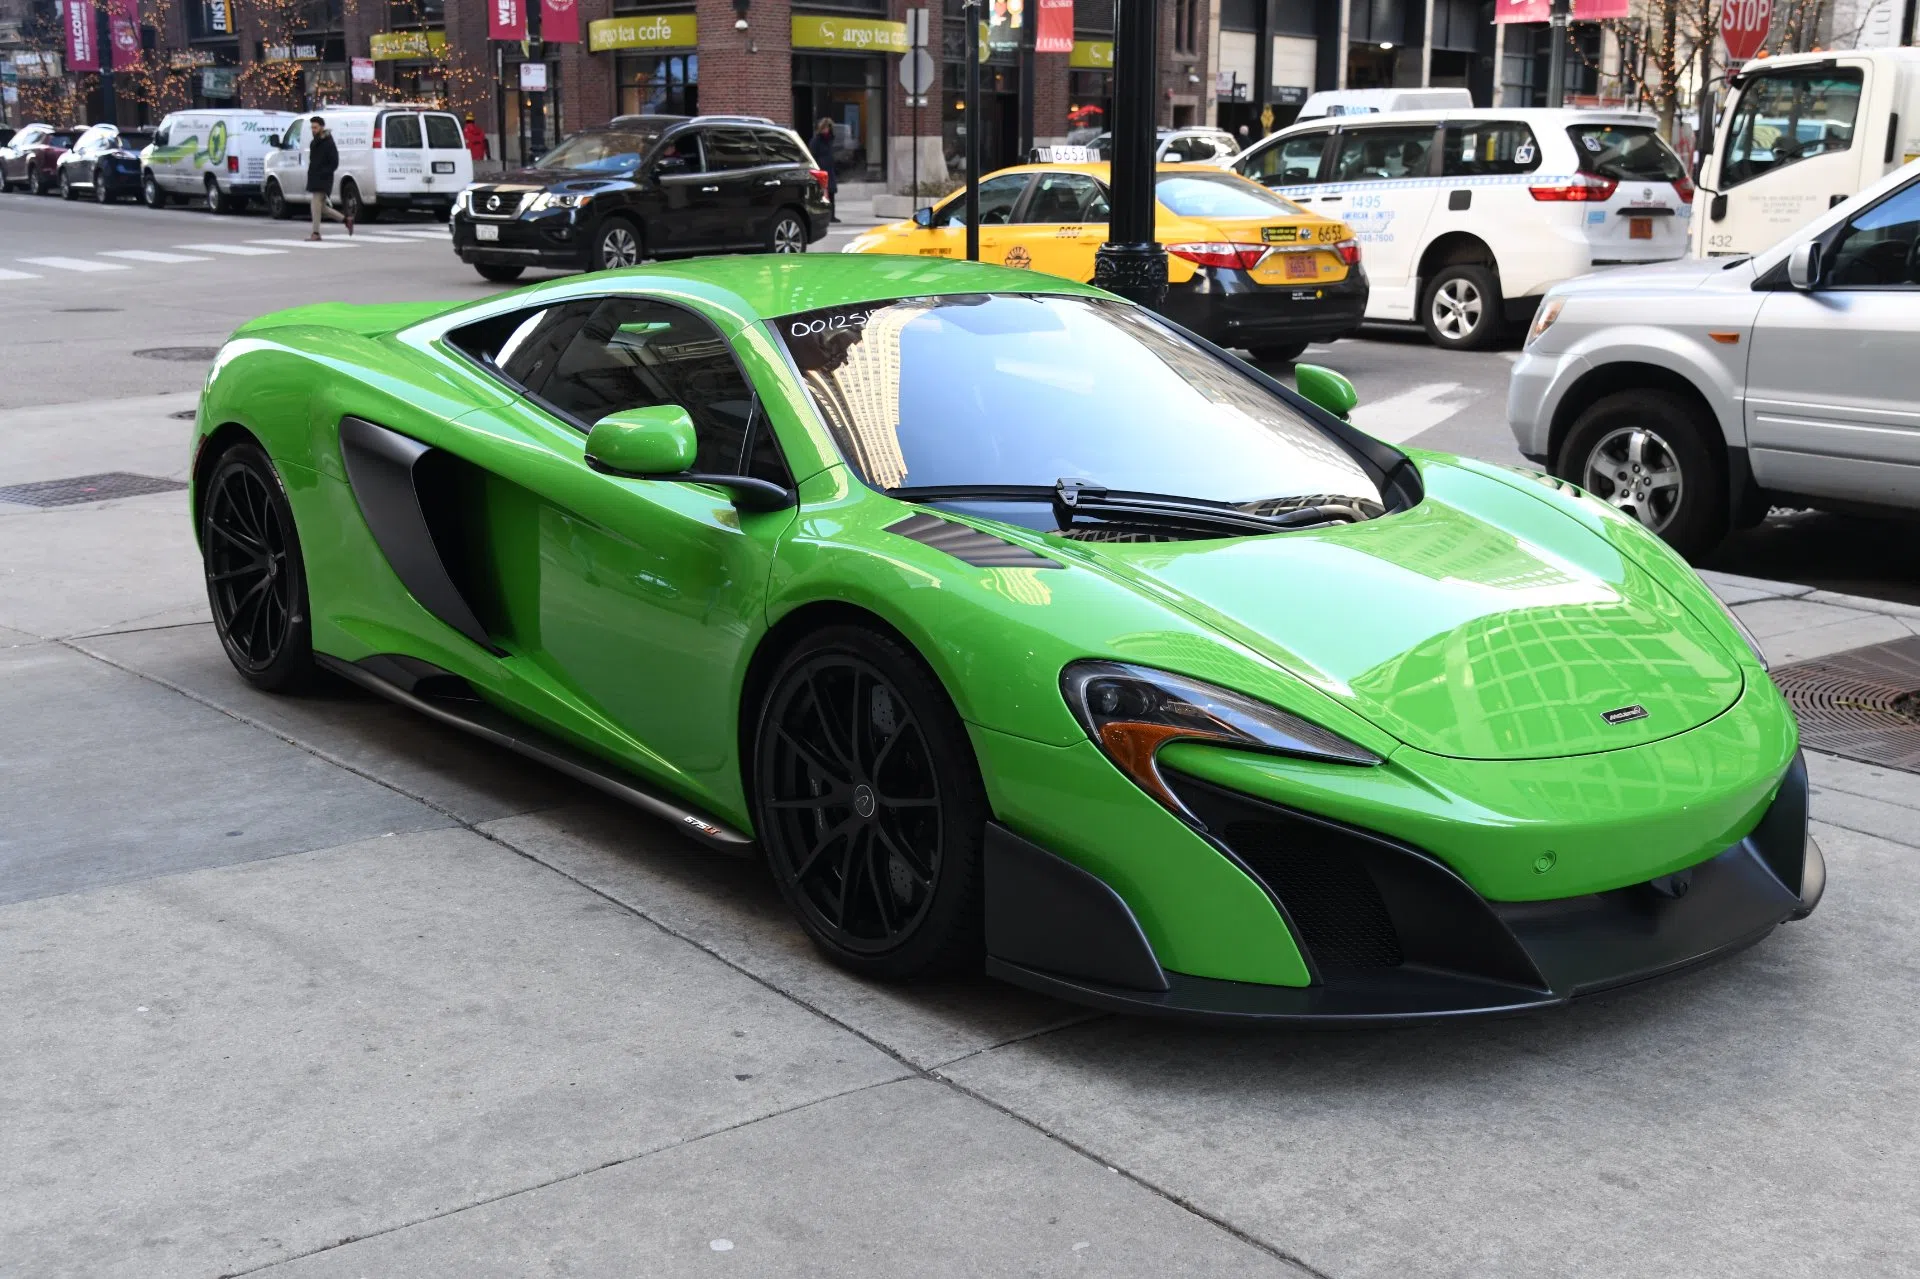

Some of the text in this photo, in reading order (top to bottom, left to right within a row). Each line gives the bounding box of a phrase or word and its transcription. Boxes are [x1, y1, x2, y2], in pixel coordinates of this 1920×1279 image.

[1724, 0, 1769, 31] STOP
[70, 2, 85, 60] WELCOME
[843, 28, 873, 47] argo
[874, 29, 889, 44] tea
[1036, 38, 1073, 50] LUMA
[1056, 147, 1085, 160] 6653
[1352, 196, 1381, 208] 1495
[1318, 225, 1342, 241] 6653
[1709, 235, 1733, 247] 432
